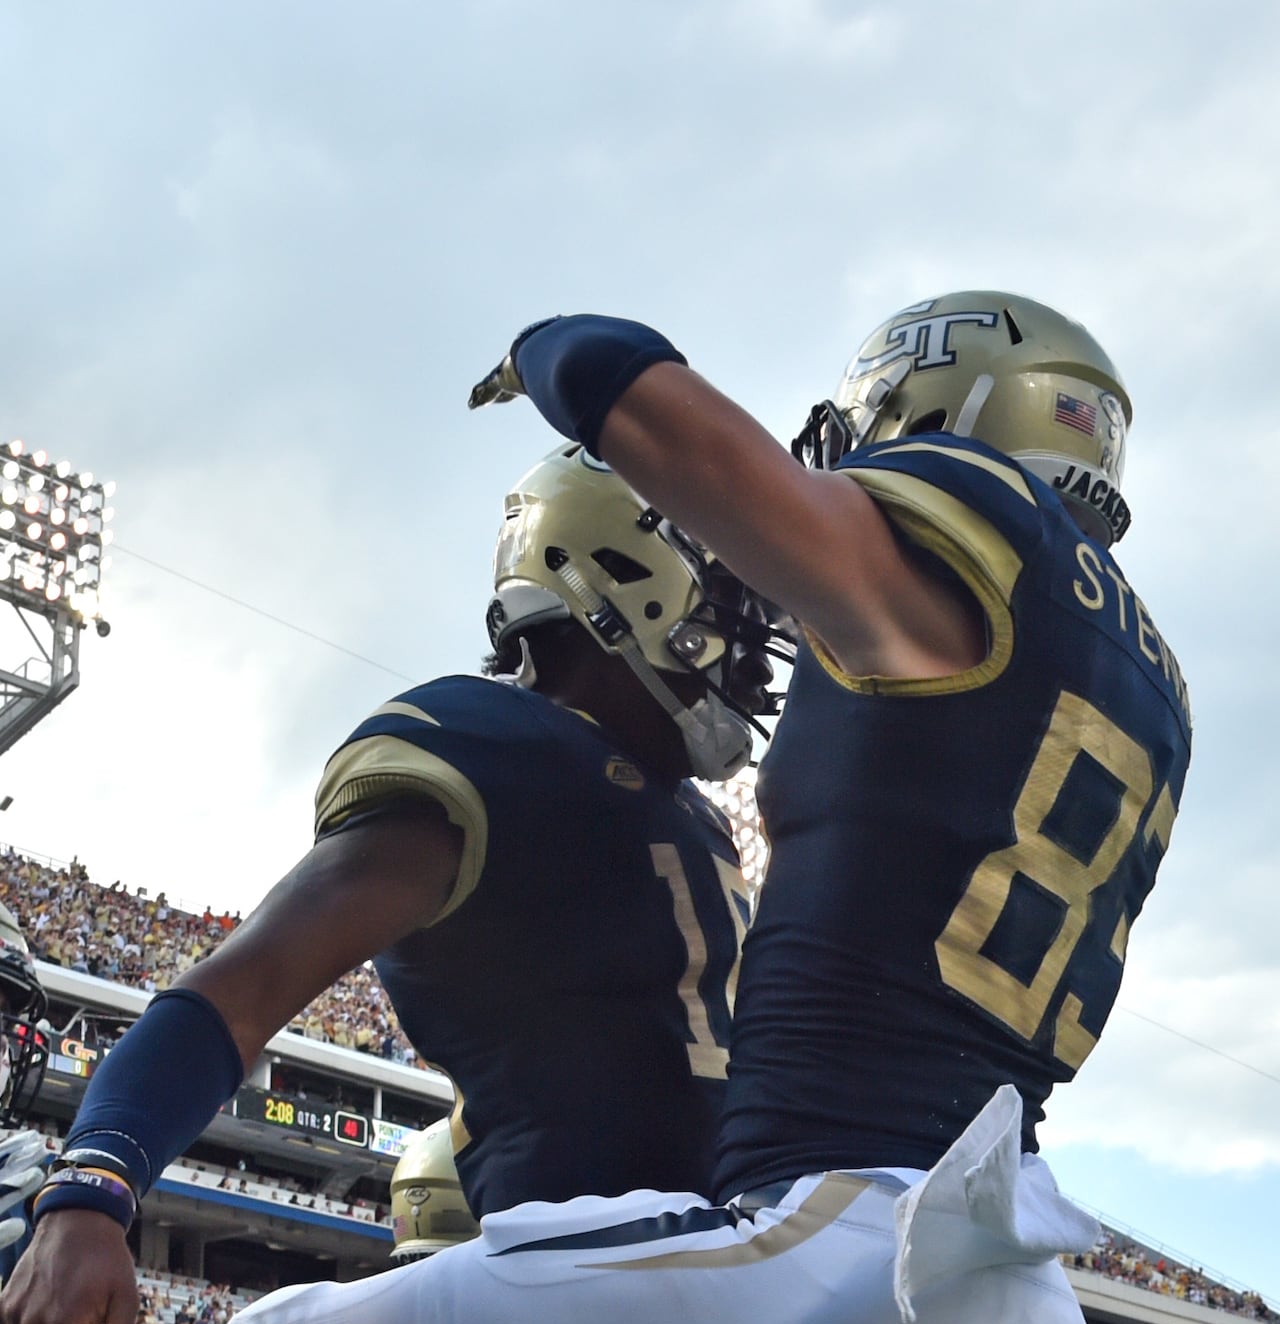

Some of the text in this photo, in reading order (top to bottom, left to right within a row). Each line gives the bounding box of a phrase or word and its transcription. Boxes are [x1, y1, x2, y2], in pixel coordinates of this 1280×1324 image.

[1054, 465, 1131, 542] JACKE
[265, 1098, 295, 1125] 2:08
[297, 1110, 320, 1129] QTR:
[323, 1114, 331, 1132] 2
[378, 1124, 403, 1139] POINTS
[393, 1141, 409, 1153] ZON
[76, 1172, 102, 1187] Life
